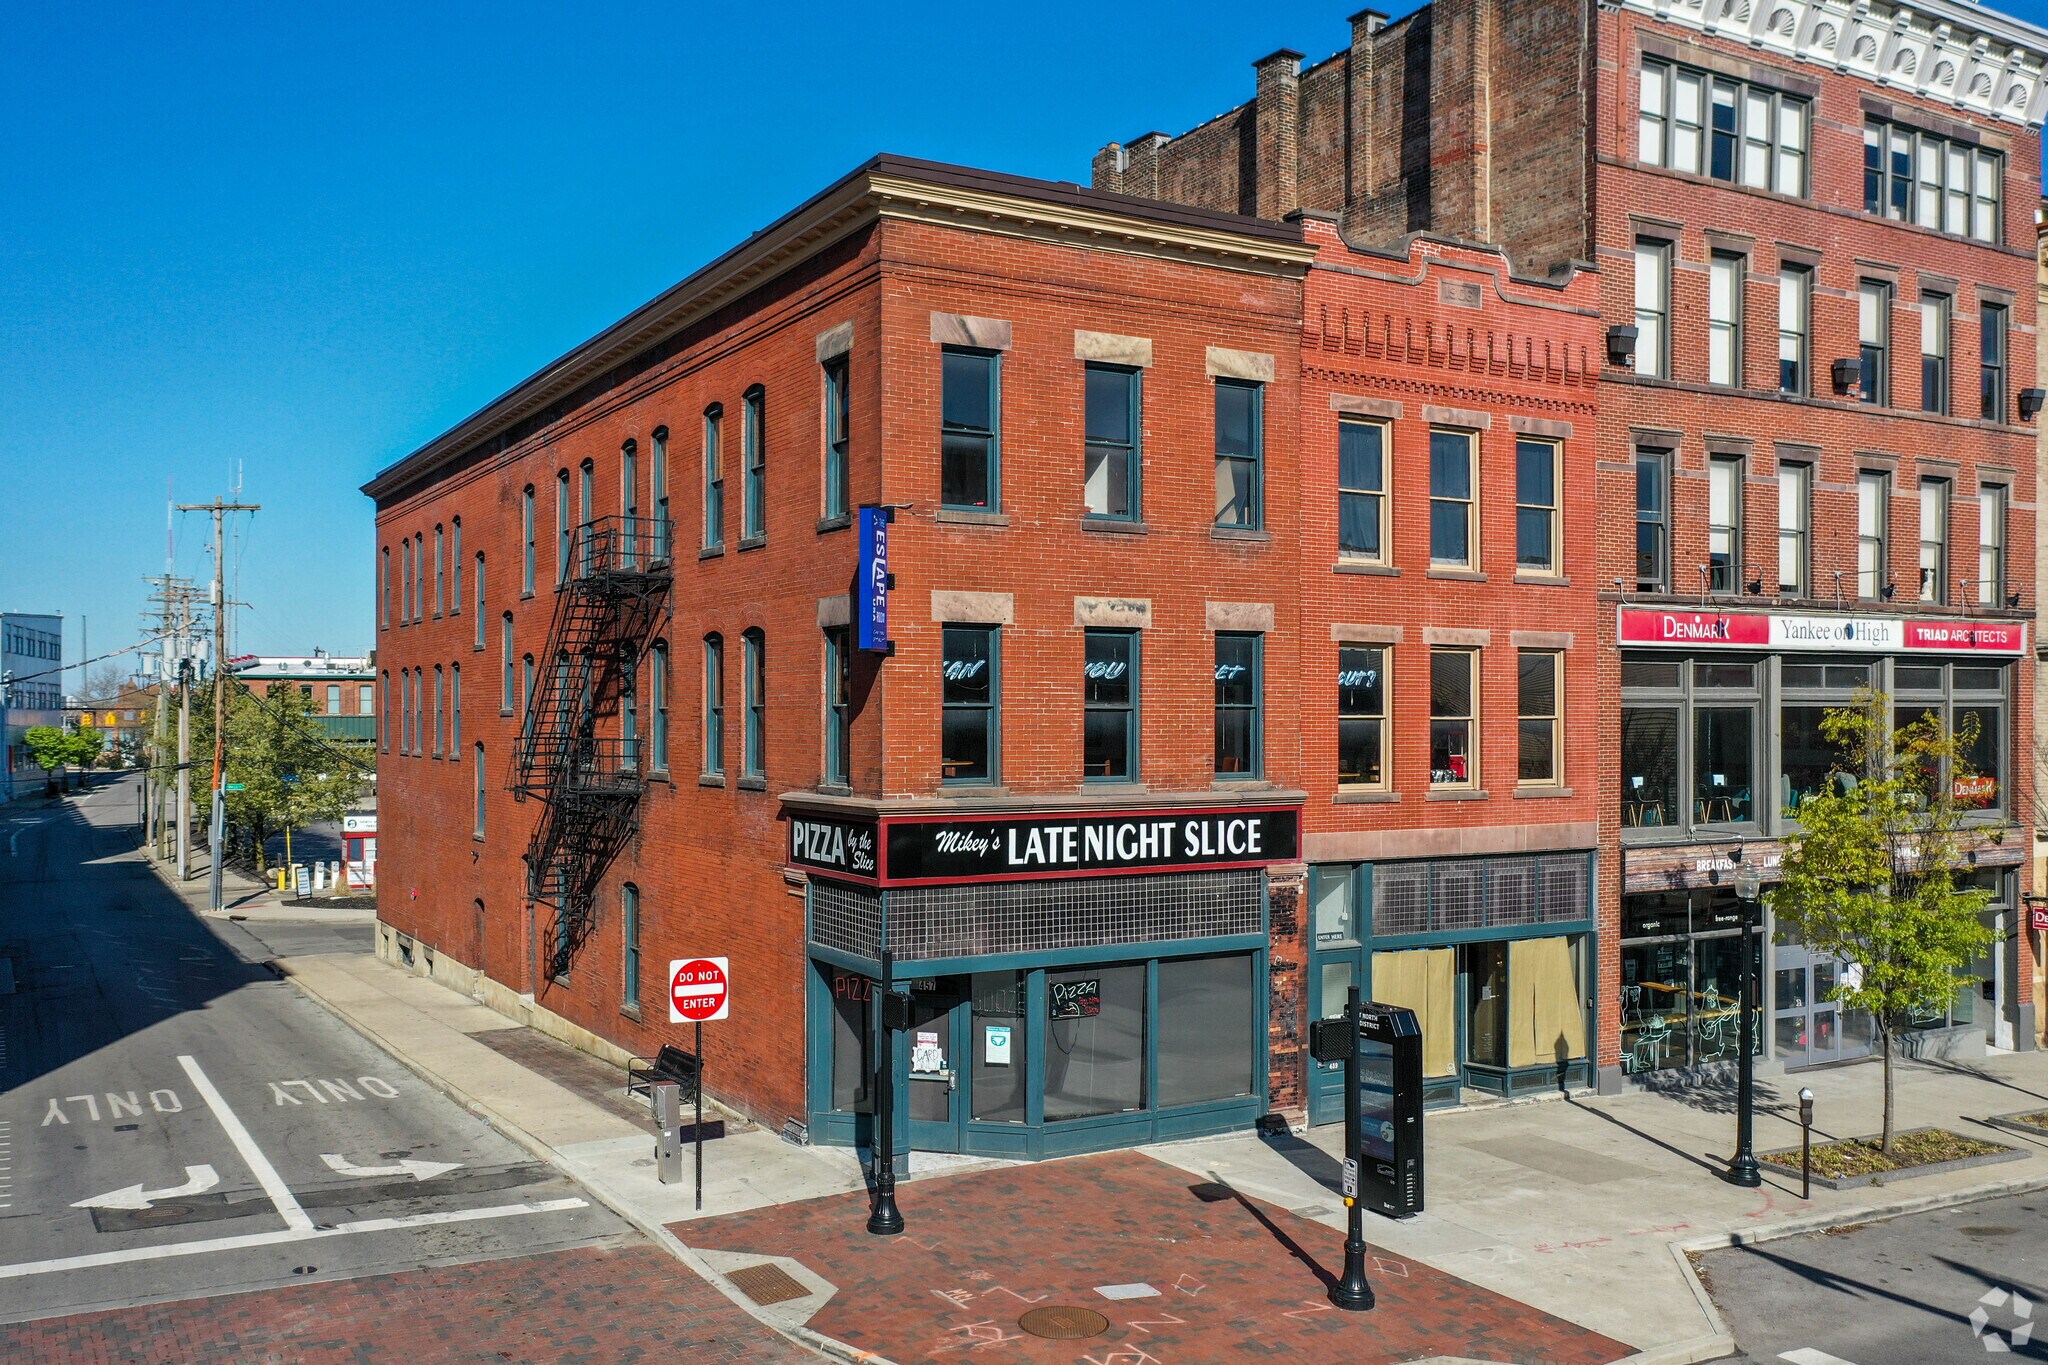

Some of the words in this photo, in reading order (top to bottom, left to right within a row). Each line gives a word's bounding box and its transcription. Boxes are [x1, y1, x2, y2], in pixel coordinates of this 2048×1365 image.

[1781, 619, 1831, 640] Yankee
[1855, 623, 1890, 646] High
[1917, 628, 1949, 641] TRIAD
[793, 820, 846, 866] PIZZA
[847, 828, 857, 853] by
[856, 831, 872, 850] the
[935, 828, 1000, 858] Mikey's
[1008, 826, 1078, 865] LATE
[1084, 822, 1176, 861] NIGHT
[1184, 819, 1262, 857] SLICE
[852, 850, 874, 871] Slice
[1642, 921, 1661, 929] organic
[679, 973, 694, 982] DO
[698, 970, 719, 981] NOT
[683, 998, 715, 1009] ENTER
[268, 1076, 400, 1107] ONLY
[41, 1088, 183, 1127] ONLY
